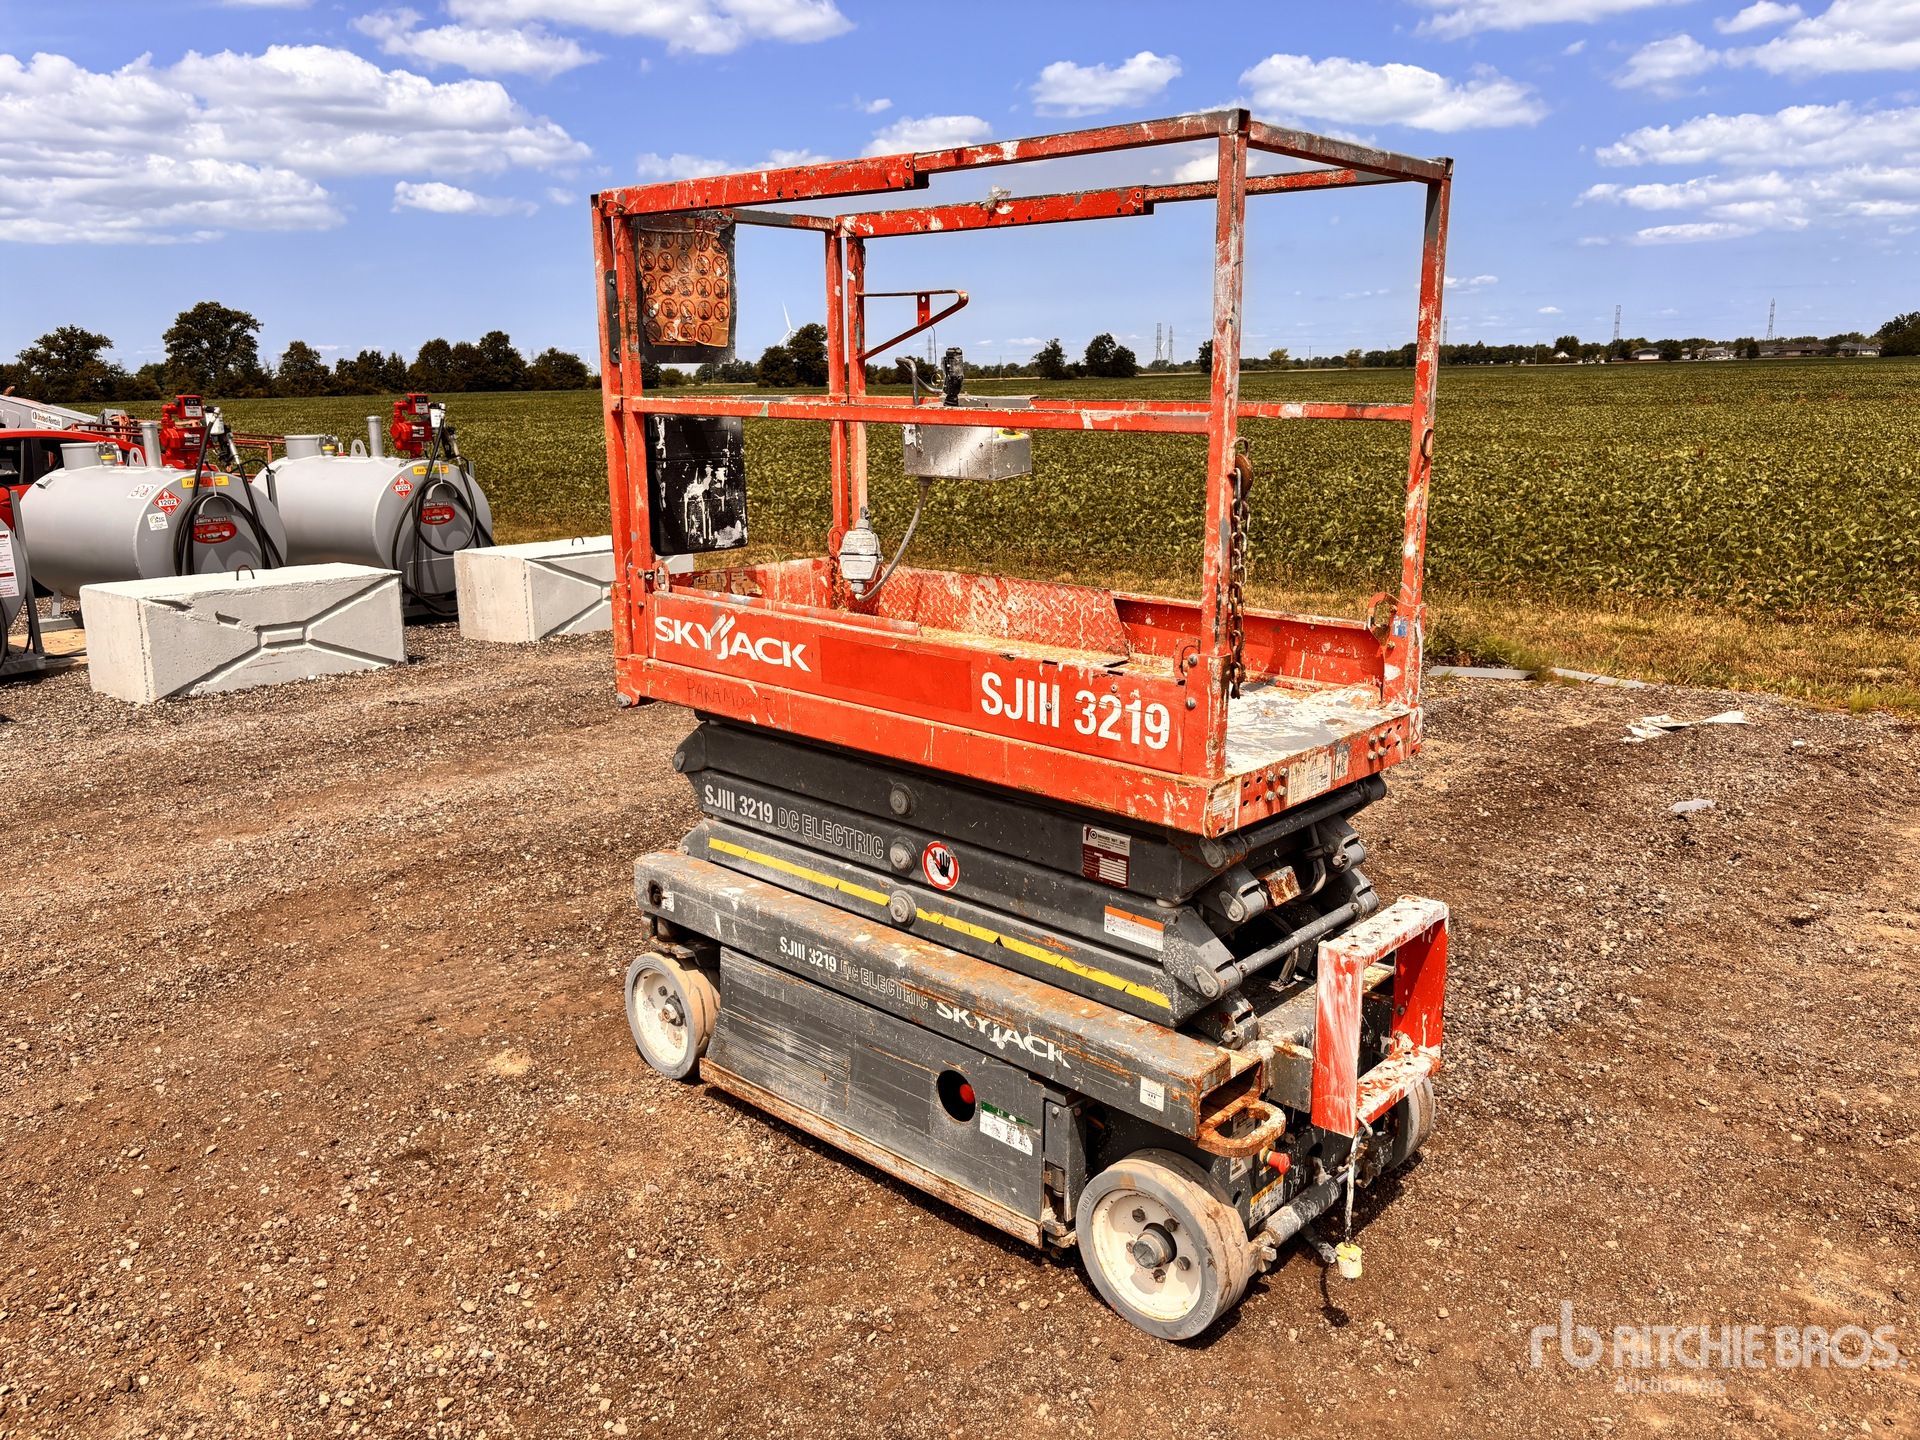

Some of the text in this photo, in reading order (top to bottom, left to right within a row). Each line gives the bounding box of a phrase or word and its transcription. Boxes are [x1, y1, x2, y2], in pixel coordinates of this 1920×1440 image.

[159, 498, 176, 506] 1202
[654, 613, 812, 673] SKYJACK
[981, 671, 1171, 750] SJIII 3219
[704, 784, 884, 859] SJIII 3219 DC ELECTRIC
[779, 936, 806, 961] SJIII
[808, 947, 837, 973] 3219
[860, 967, 929, 1010] ELECTRIC
[936, 1001, 1072, 1069] SKYJACK
